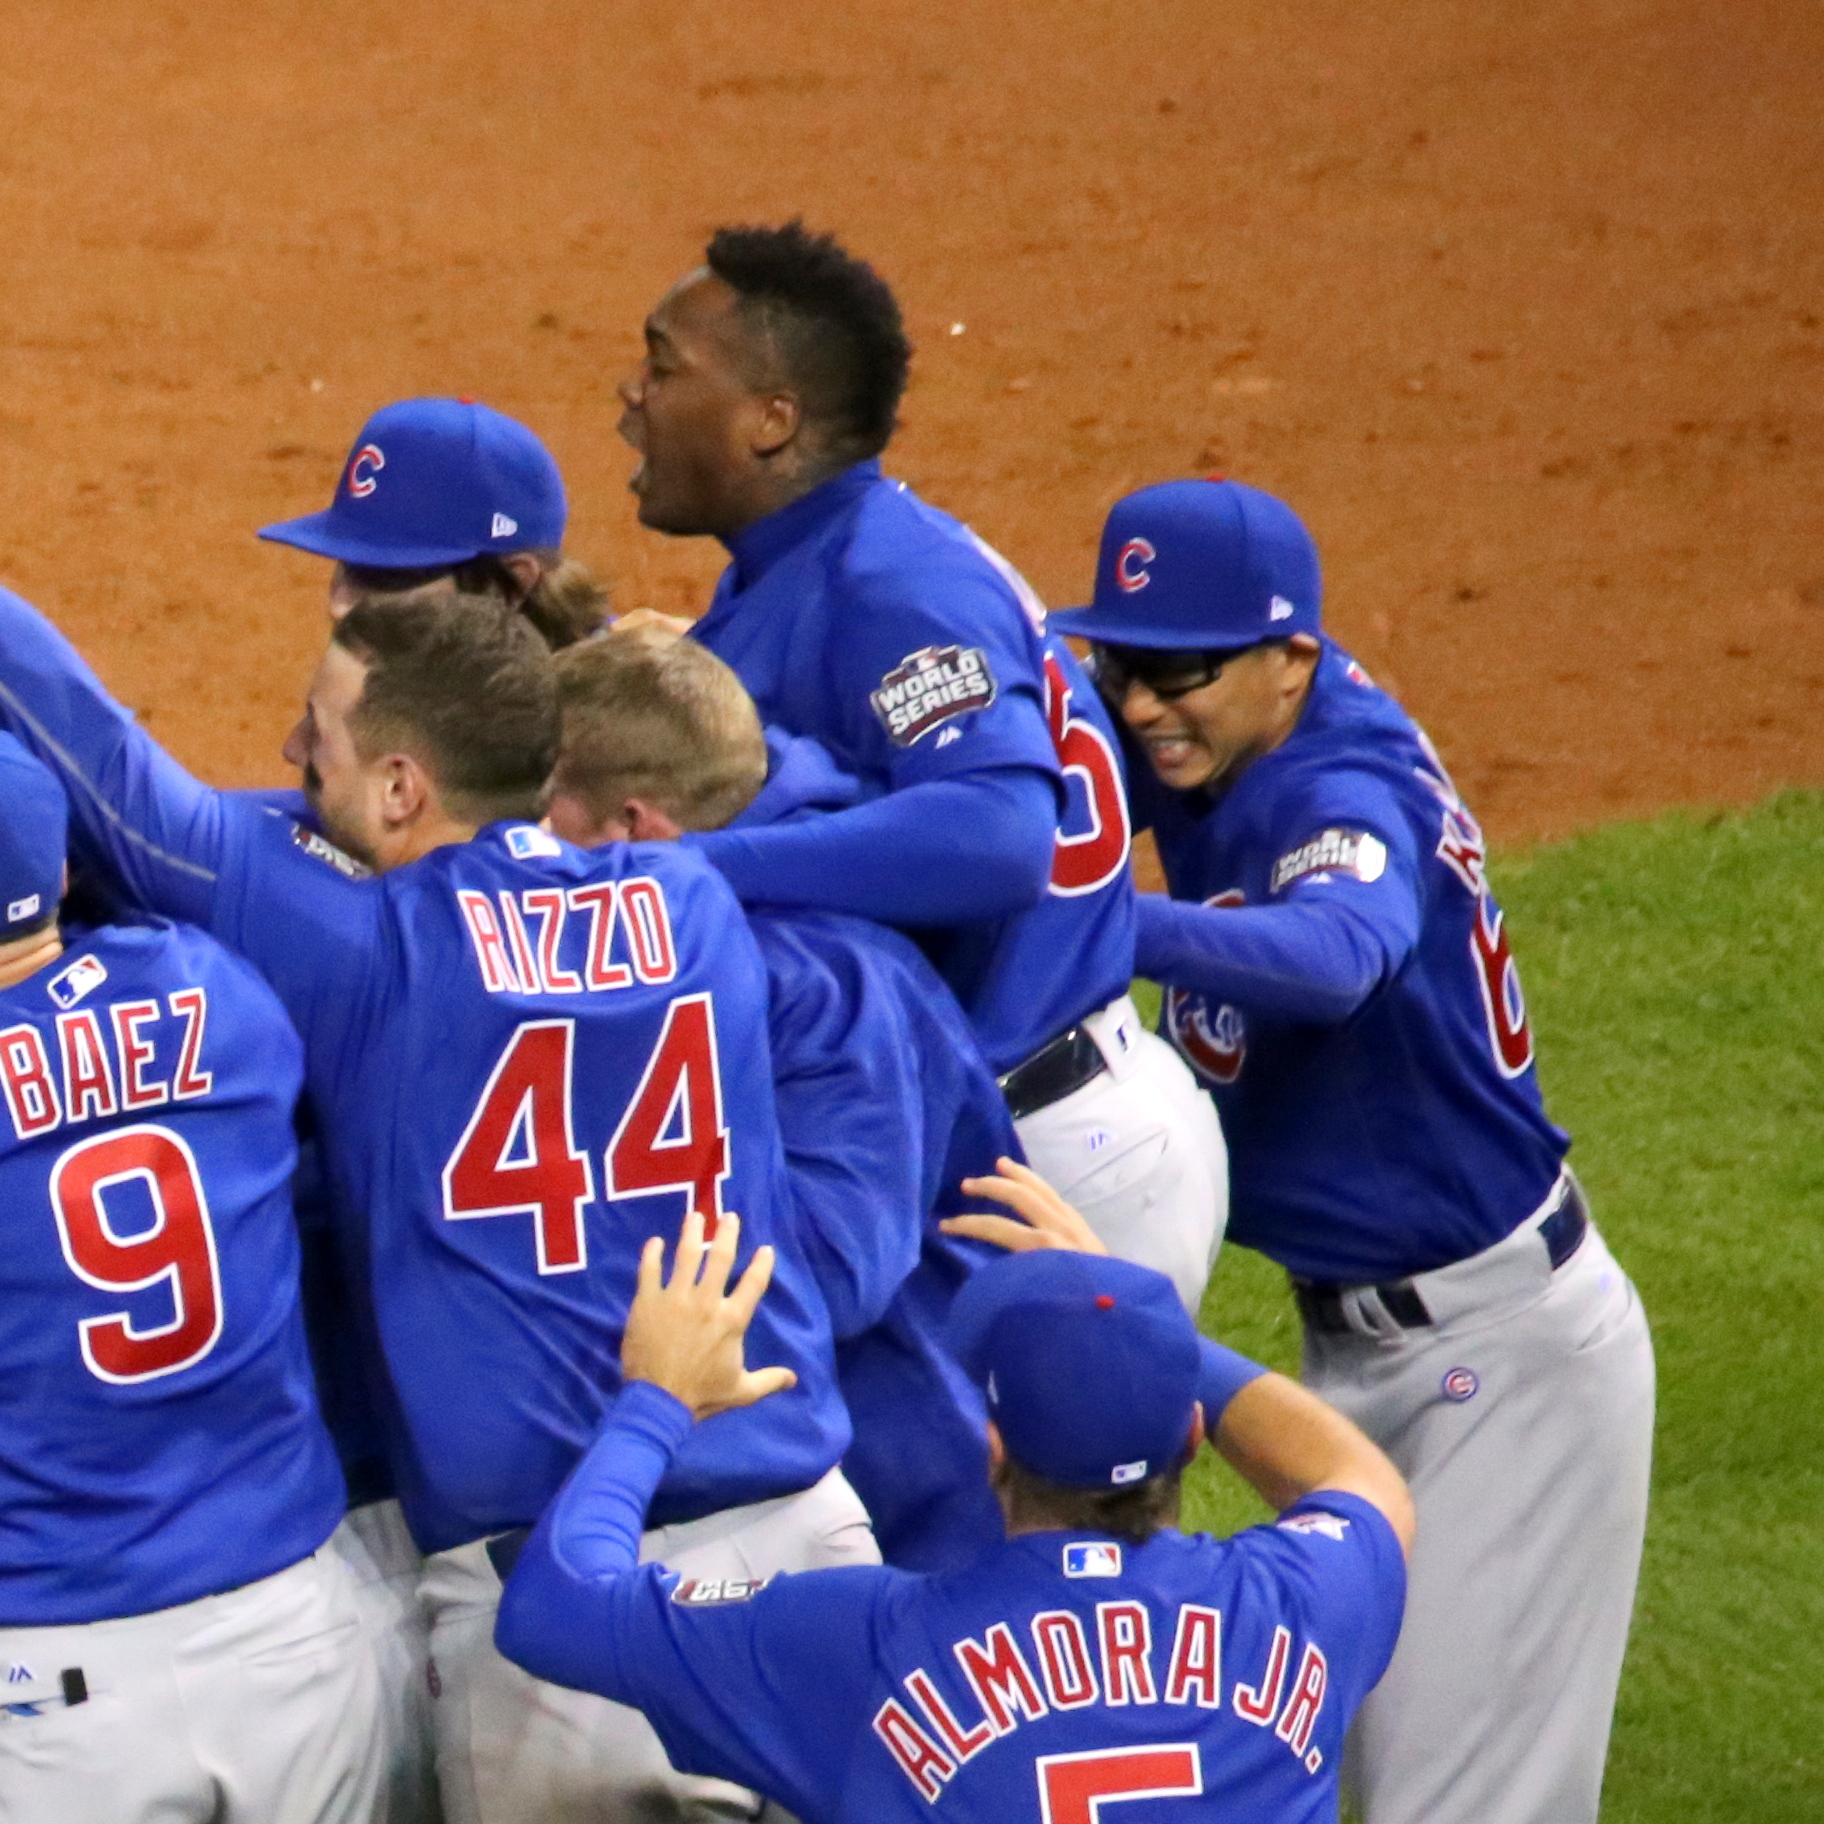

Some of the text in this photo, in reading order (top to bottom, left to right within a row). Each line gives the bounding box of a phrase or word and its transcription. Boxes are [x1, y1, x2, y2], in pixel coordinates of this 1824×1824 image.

[351, 444, 385, 498] C
[1116, 536, 1156, 594] C
[877, 648, 981, 712] WORLD
[887, 671, 989, 735] SERIES
[457, 876, 677, 995] RIZZO
[441, 991, 732, 1276] 44
[49, 1123, 224, 1386] 9
[871, 1599, 1328, 1804] ALMORA JR.
